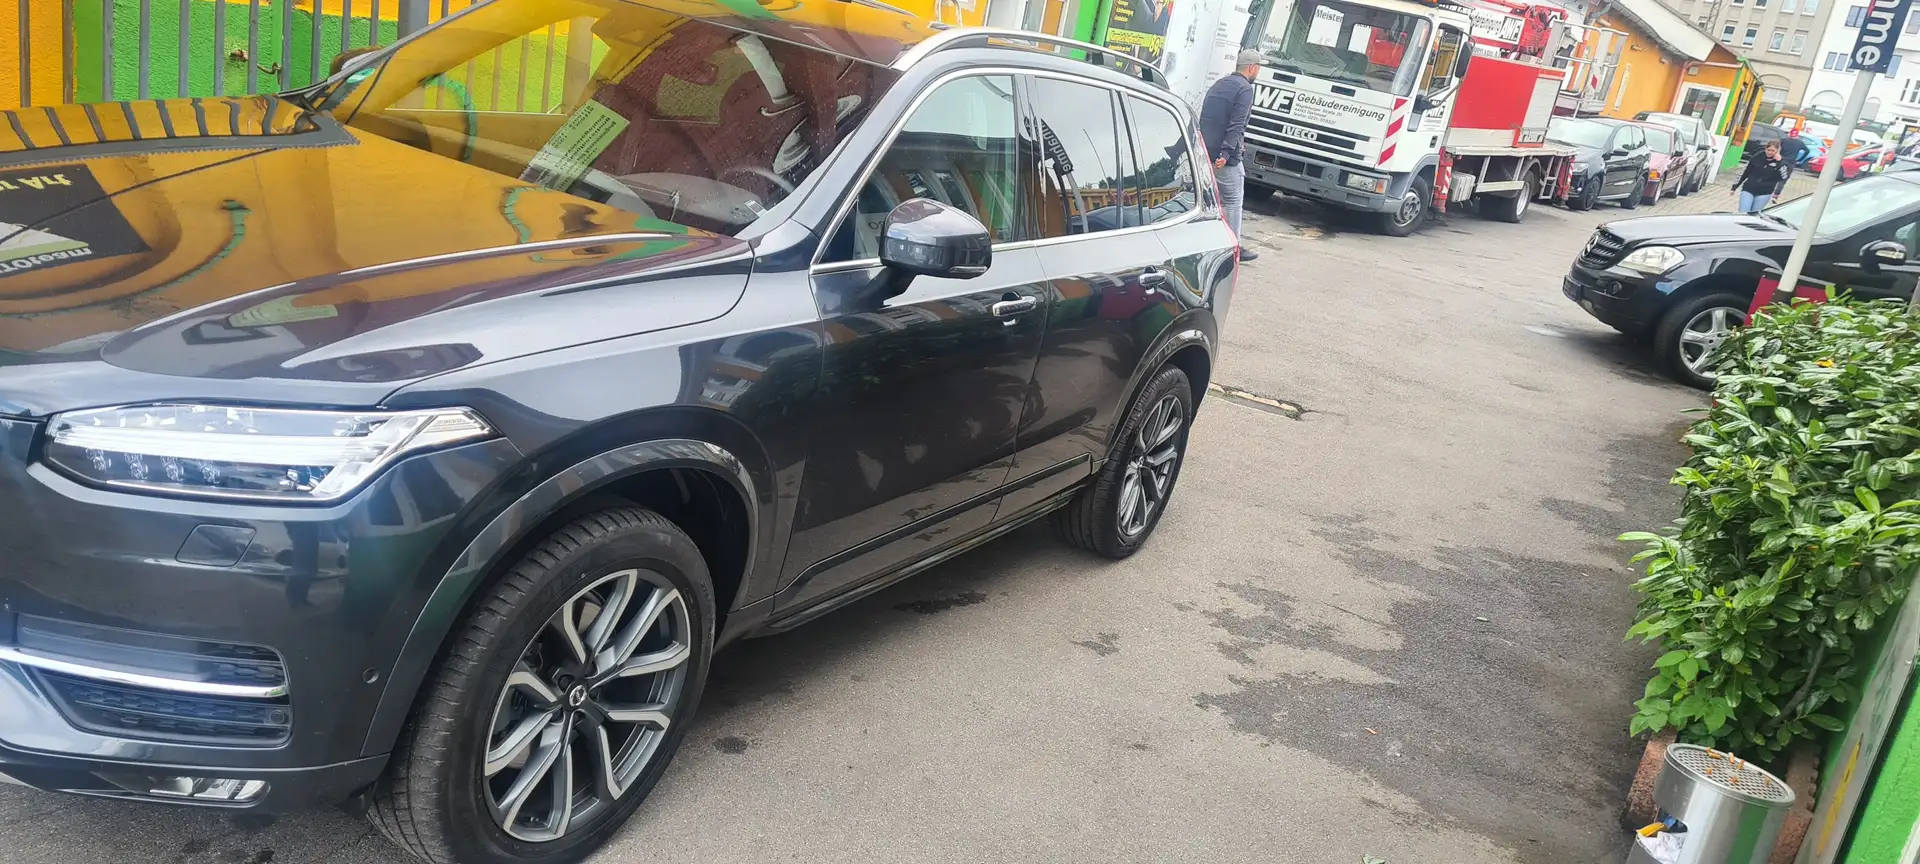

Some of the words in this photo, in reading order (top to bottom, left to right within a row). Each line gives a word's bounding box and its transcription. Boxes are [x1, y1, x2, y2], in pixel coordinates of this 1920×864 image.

[1251, 84, 1294, 112] WF
[1297, 93, 1385, 121] Gebäudereinigung
[1282, 125, 1318, 141] IVECO
